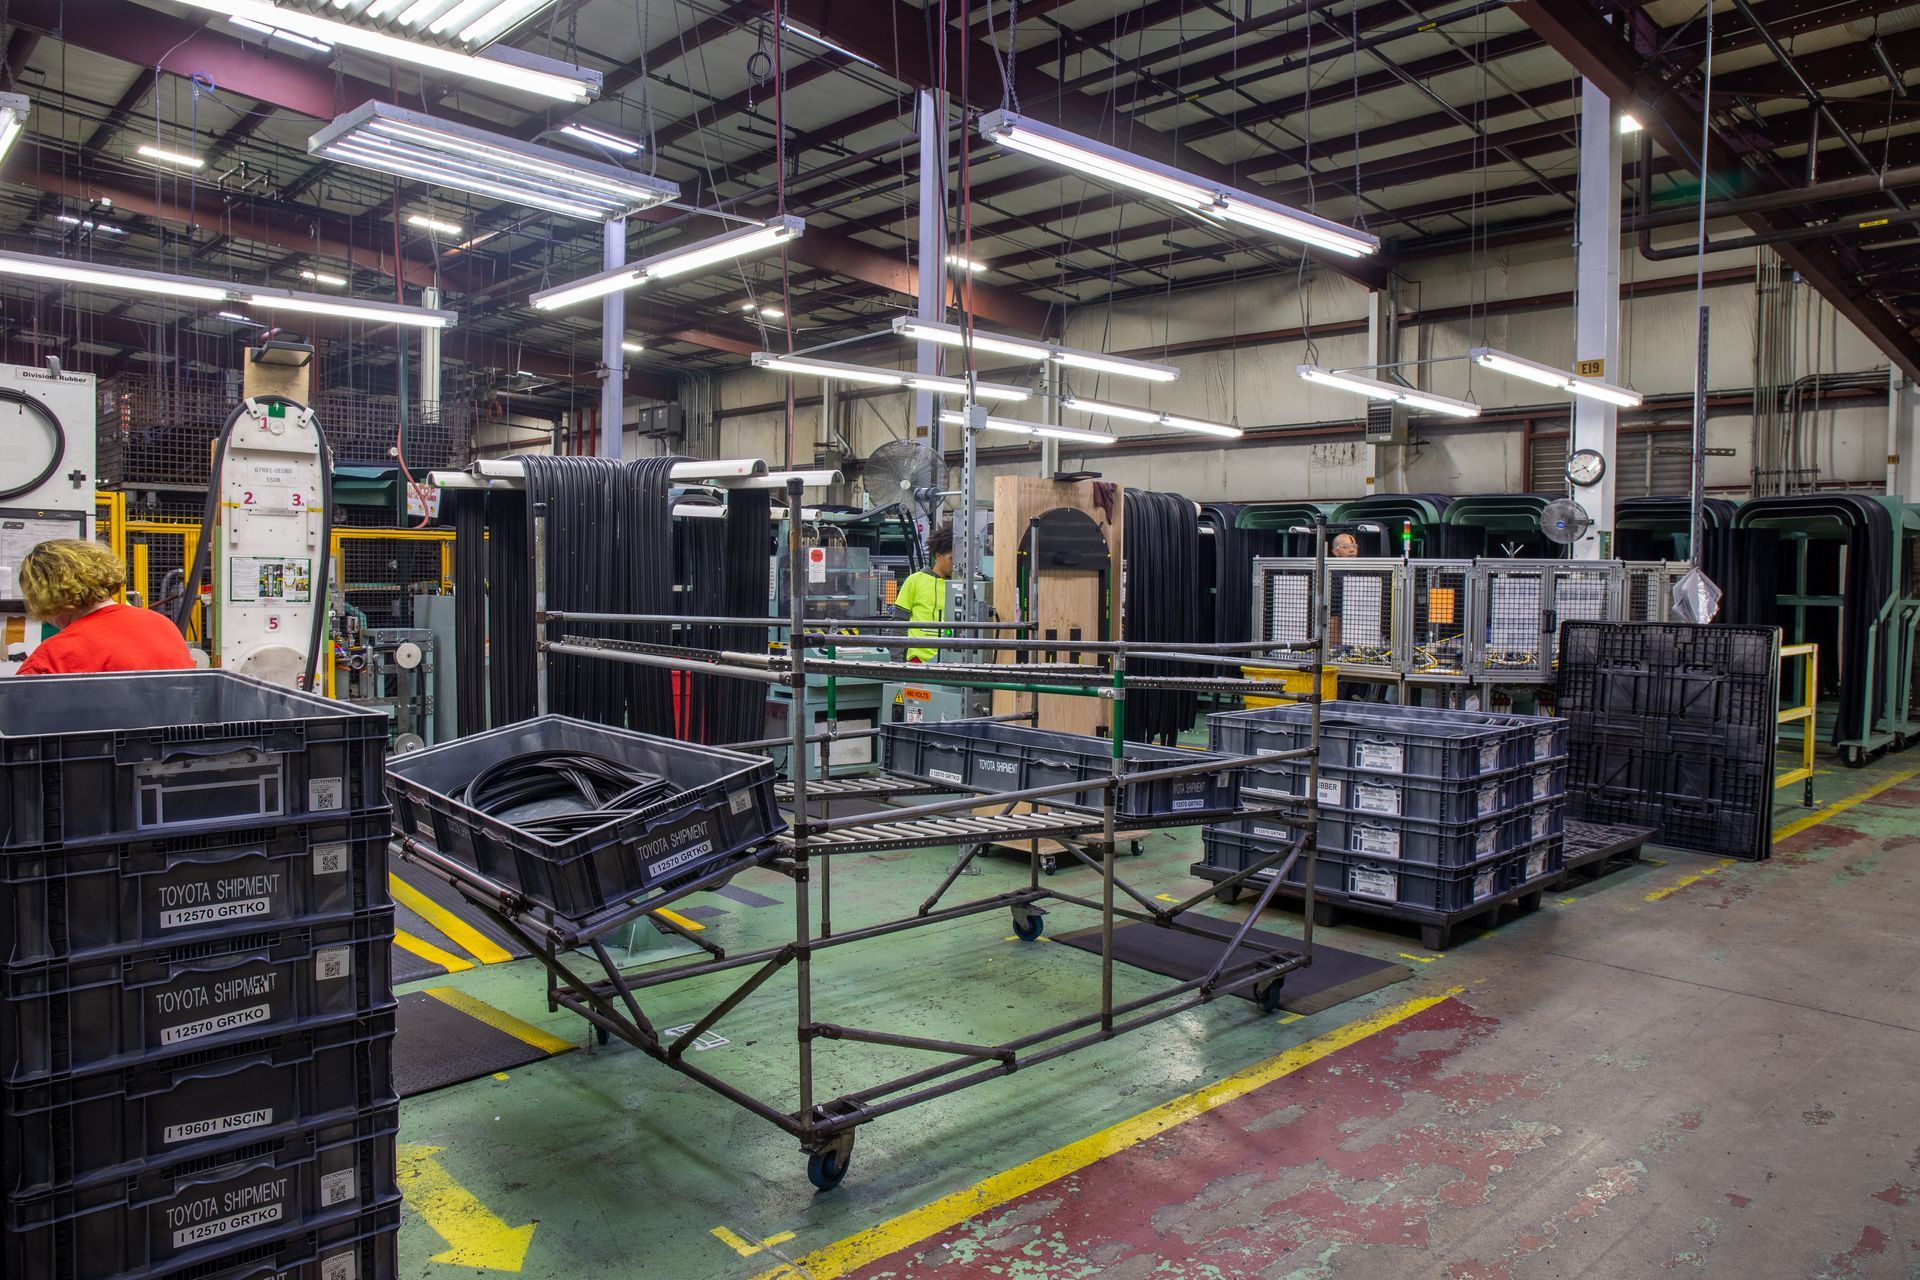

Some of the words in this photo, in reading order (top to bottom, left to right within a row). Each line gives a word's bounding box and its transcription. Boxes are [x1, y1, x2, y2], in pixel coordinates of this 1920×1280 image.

[1581, 362, 1600, 374] E19
[59, 375, 87, 383] Rubber
[260, 416, 269, 429] 1
[243, 491, 254, 505] 2
[291, 493, 302, 507] 3
[269, 617, 278, 629] 5
[915, 691, 929, 699] VOLTS
[979, 759, 995, 771] TOYOTA
[996, 761, 1018, 774] SHIPMENT
[1317, 781, 1338, 792] UBBER
[638, 837, 670, 861] TOYOTA
[670, 821, 708, 846] SHIPMENT
[657, 858, 680, 872] 12570
[681, 844, 709, 861] GRTKO
[159, 882, 211, 907] TOYOTA
[217, 874, 280, 899] SHIPMENT
[168, 914, 172, 924] I
[176, 909, 214, 922] 12570
[218, 901, 265, 917] GRTKO
[156, 986, 209, 1014] TOYOTA
[167, 1031, 171, 1040] I
[174, 1021, 213, 1039] 12570
[217, 1008, 264, 1028] GRTKO
[168, 1128, 171, 1138] I
[177, 1120, 217, 1136] 19601
[222, 1111, 266, 1128] NSCIN
[332, 1170, 353, 1178] TOYOTA
[166, 1197, 218, 1228] TOYOTA
[224, 1178, 287, 1212] SHIPMENT
[181, 1232, 185, 1242] I
[189, 1221, 227, 1239] 12570
[230, 1208, 278, 1228] GRTKO
[331, 1252, 353, 1263] TOYOTA
